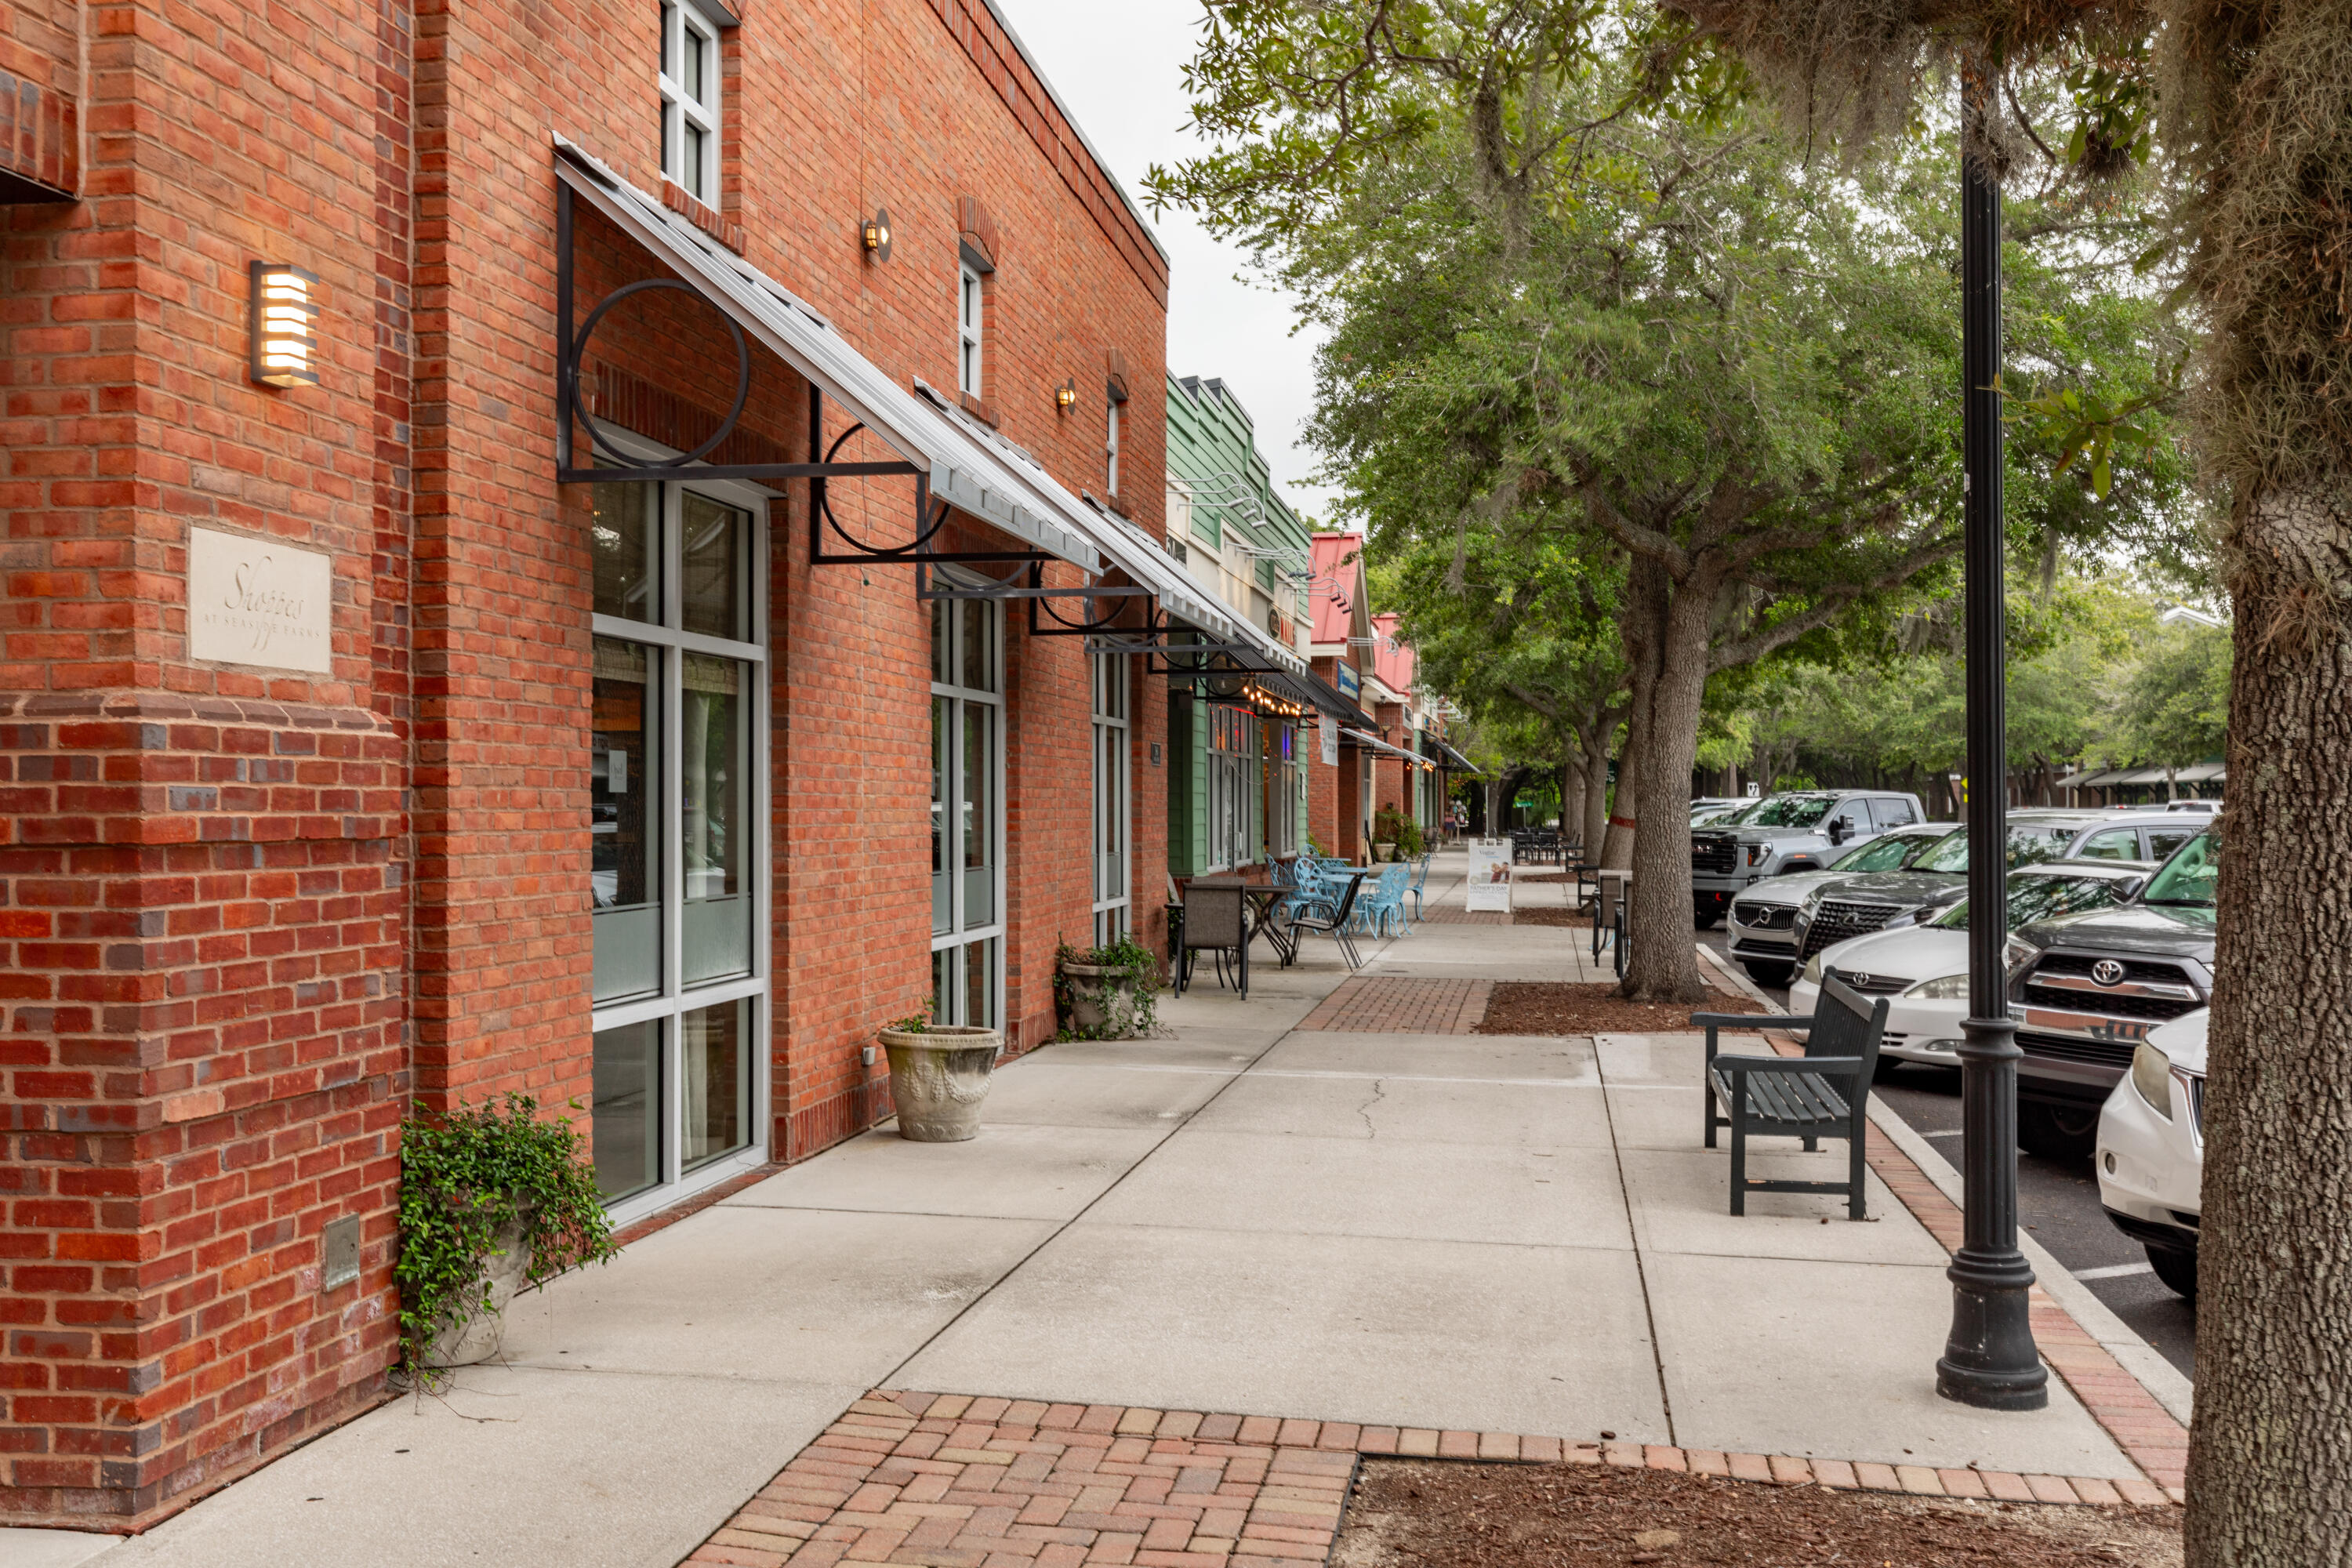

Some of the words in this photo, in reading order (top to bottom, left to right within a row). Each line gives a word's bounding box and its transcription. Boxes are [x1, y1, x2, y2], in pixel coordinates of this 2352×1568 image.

[224, 555, 304, 652] Shoppes
[204, 613, 218, 624] AT
[224, 616, 278, 633] SEASIDE
[283, 625, 320, 638] FARMS
[1280, 616, 1295, 647] NAILS
